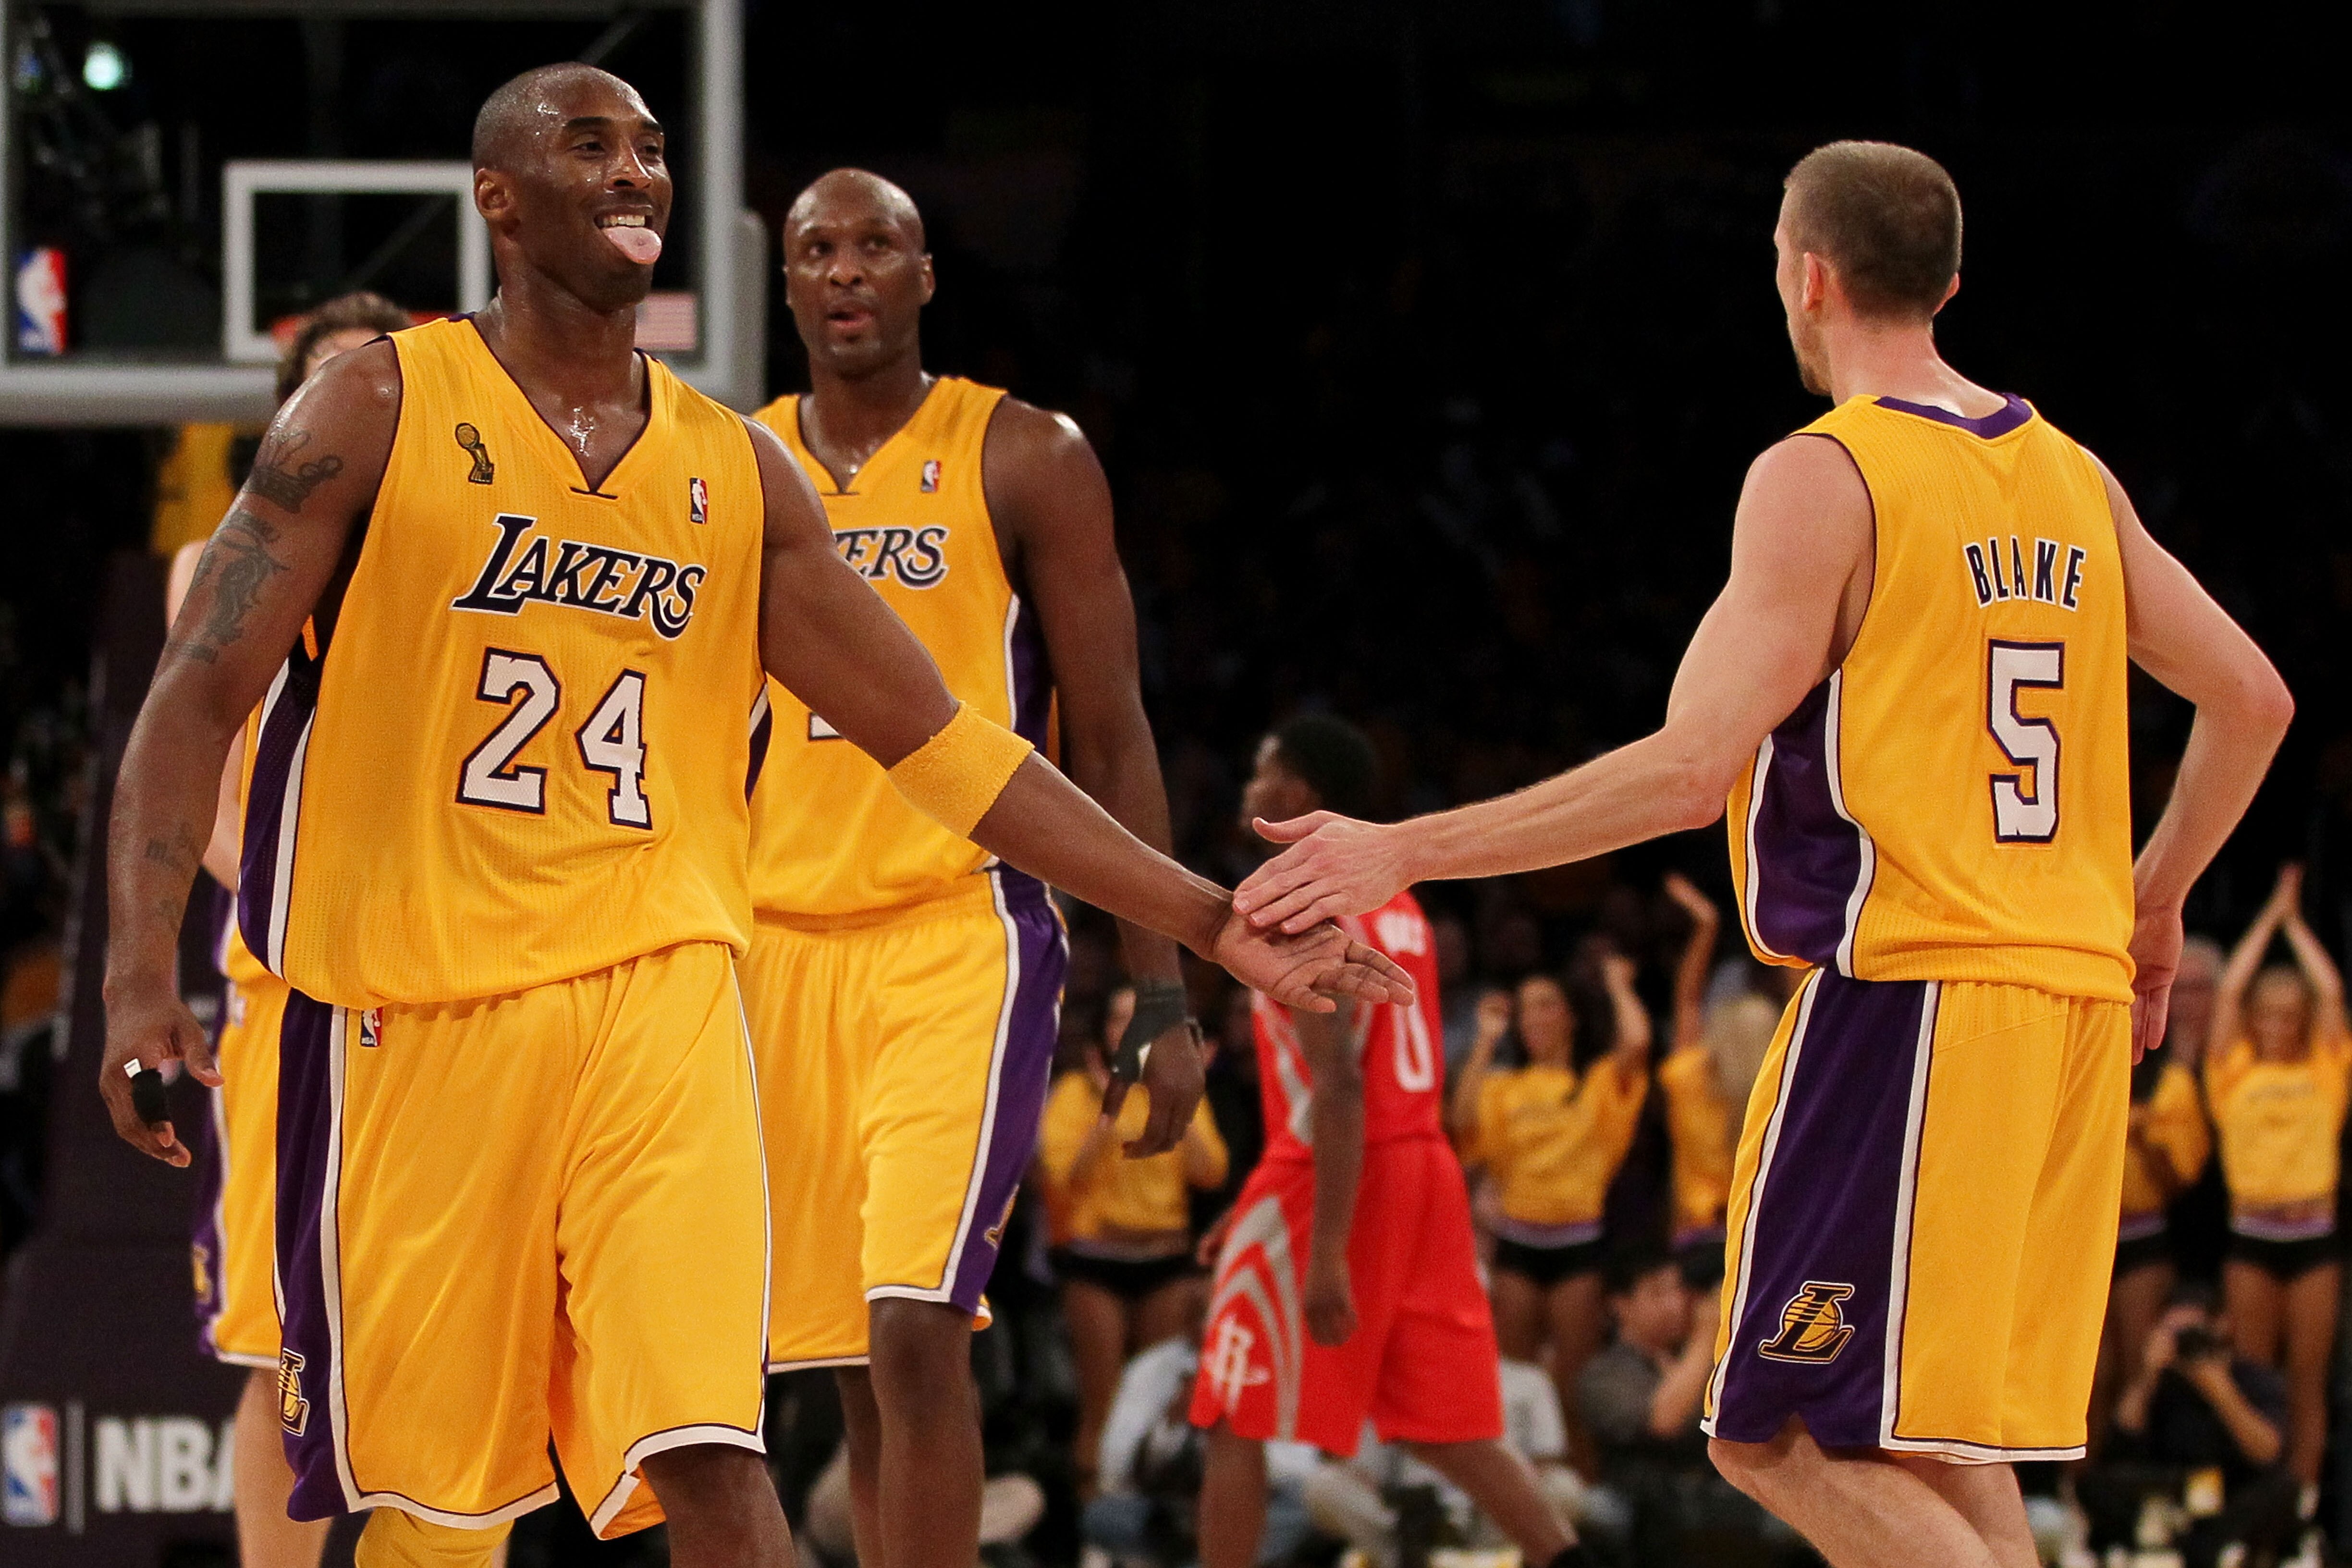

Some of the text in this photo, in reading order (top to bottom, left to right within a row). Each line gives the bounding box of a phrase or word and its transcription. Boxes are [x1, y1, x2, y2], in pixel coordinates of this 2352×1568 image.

[449, 512, 708, 640] LAKERS
[834, 524, 949, 589] ERS
[1963, 535, 2087, 613] BLAKE
[455, 647, 652, 830] 24
[1986, 638, 2065, 844] 5
